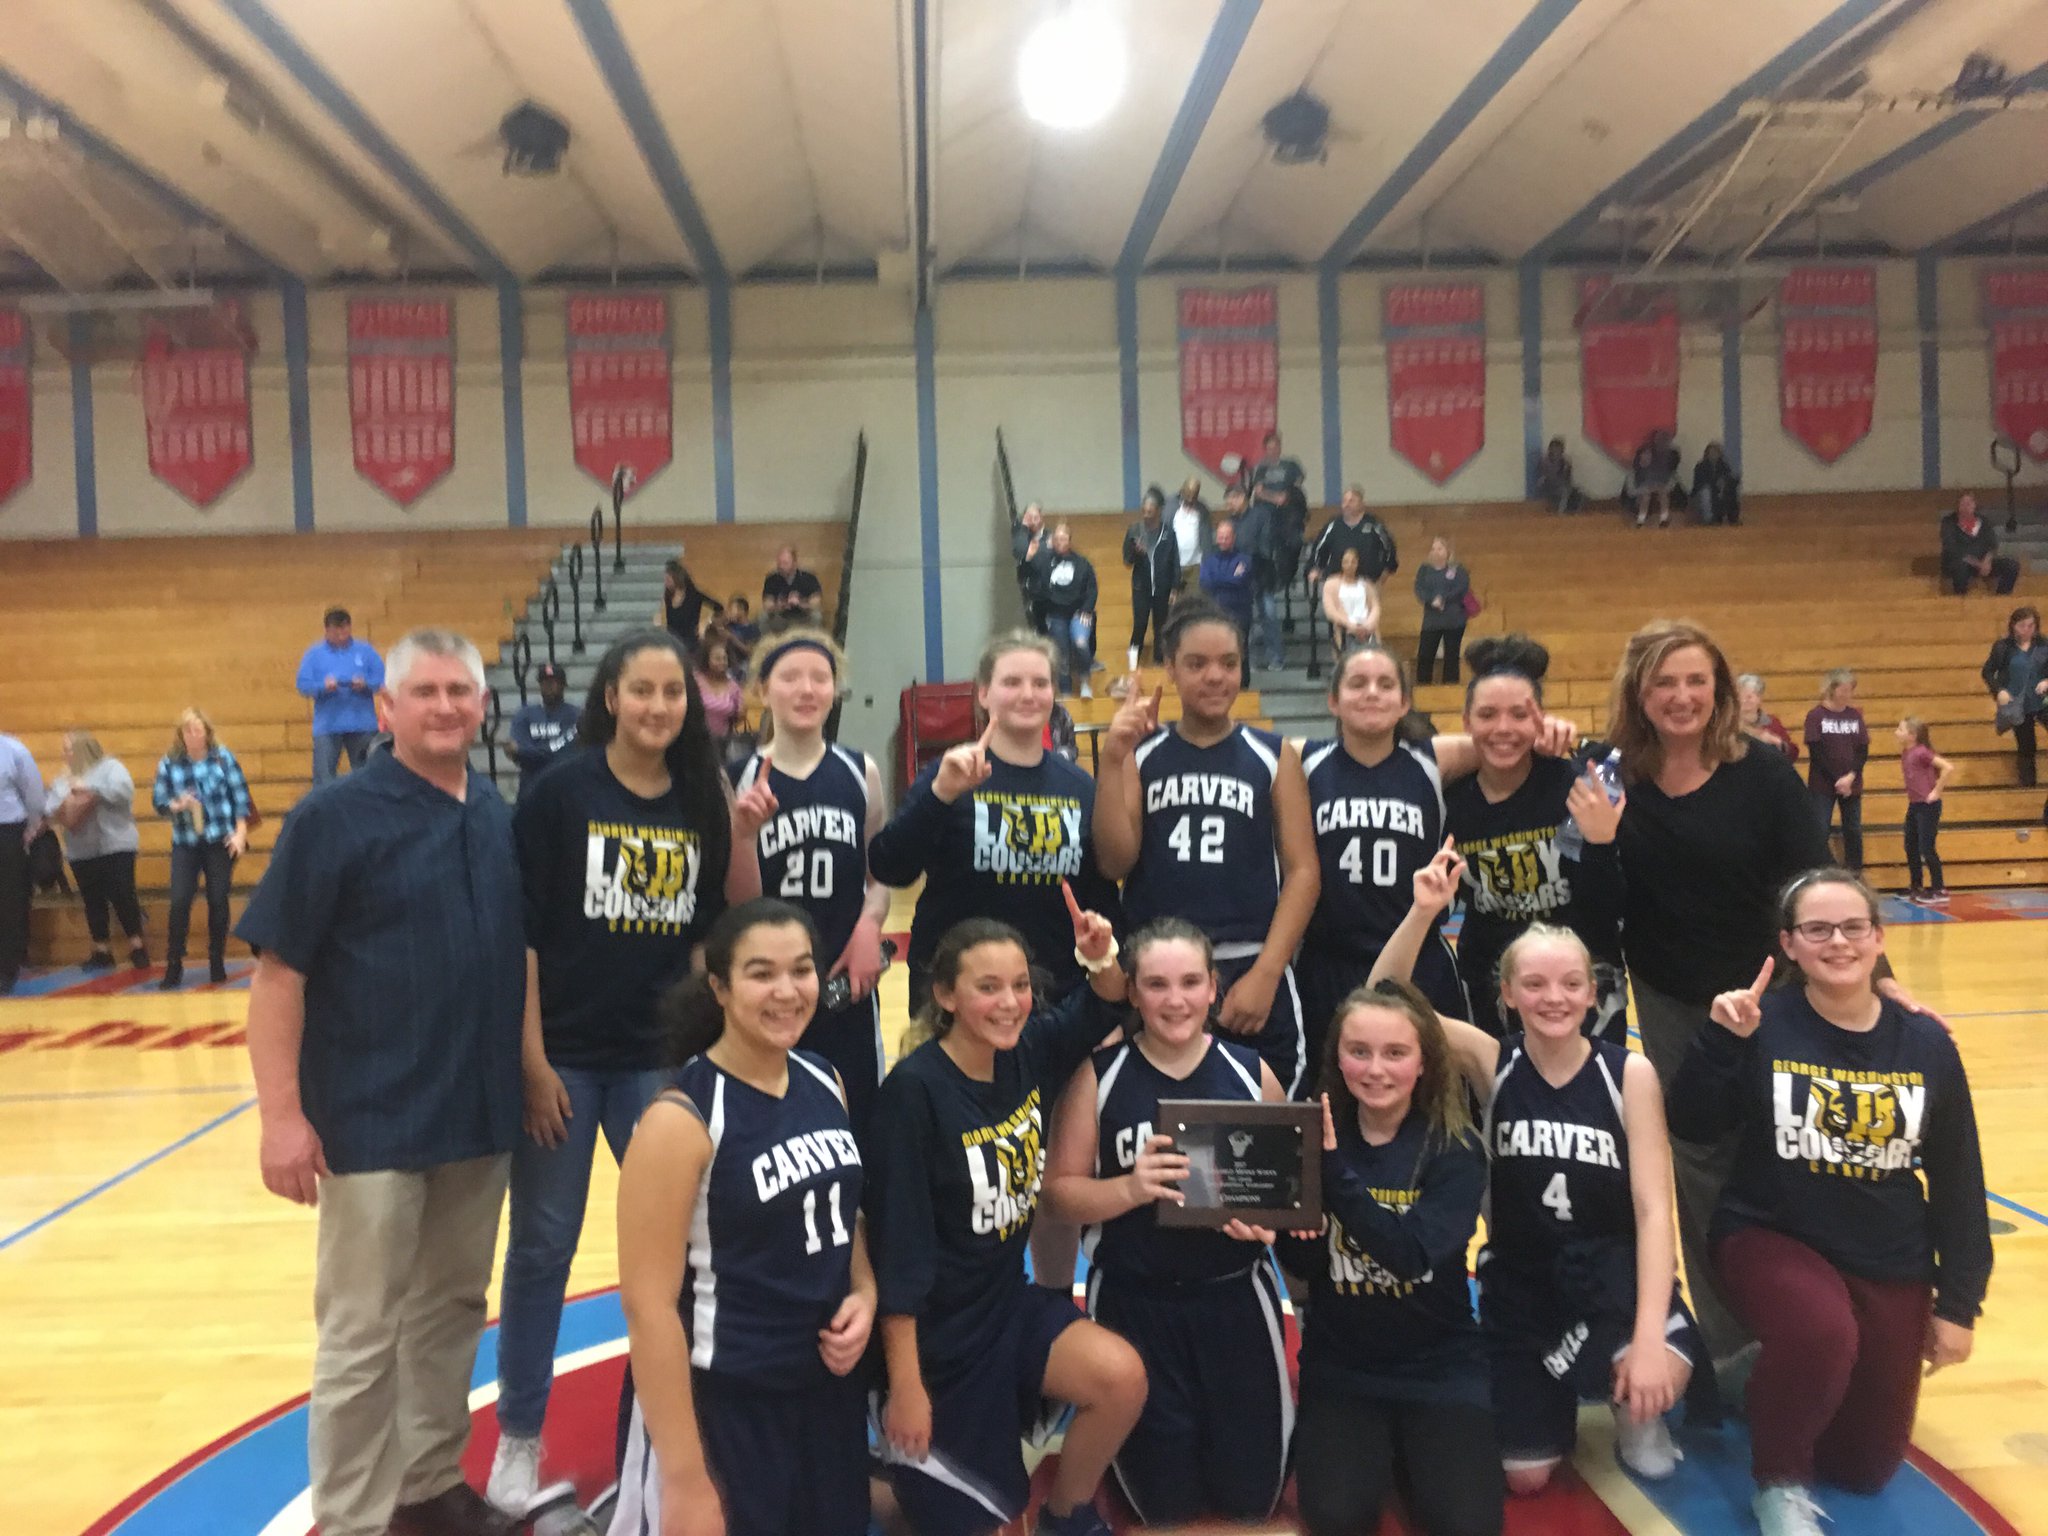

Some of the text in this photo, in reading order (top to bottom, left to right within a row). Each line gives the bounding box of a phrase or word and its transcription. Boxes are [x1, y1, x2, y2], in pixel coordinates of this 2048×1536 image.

[1147, 772, 1254, 819] CARVER
[1316, 797, 1425, 840] CARVER
[760, 804, 857, 859] CARVER
[1168, 814, 1226, 864] 42
[780, 848, 834, 899] 20
[1339, 836, 1398, 887] 40
[1773, 1059, 1827, 1078] GEORGE
[1497, 1119, 1621, 1169] CARVER
[1776, 1126, 1921, 1169] COUGAR
[1810, 1160, 1890, 1183] CARVE
[803, 1181, 849, 1256] 11
[1542, 1172, 1573, 1221] 4
